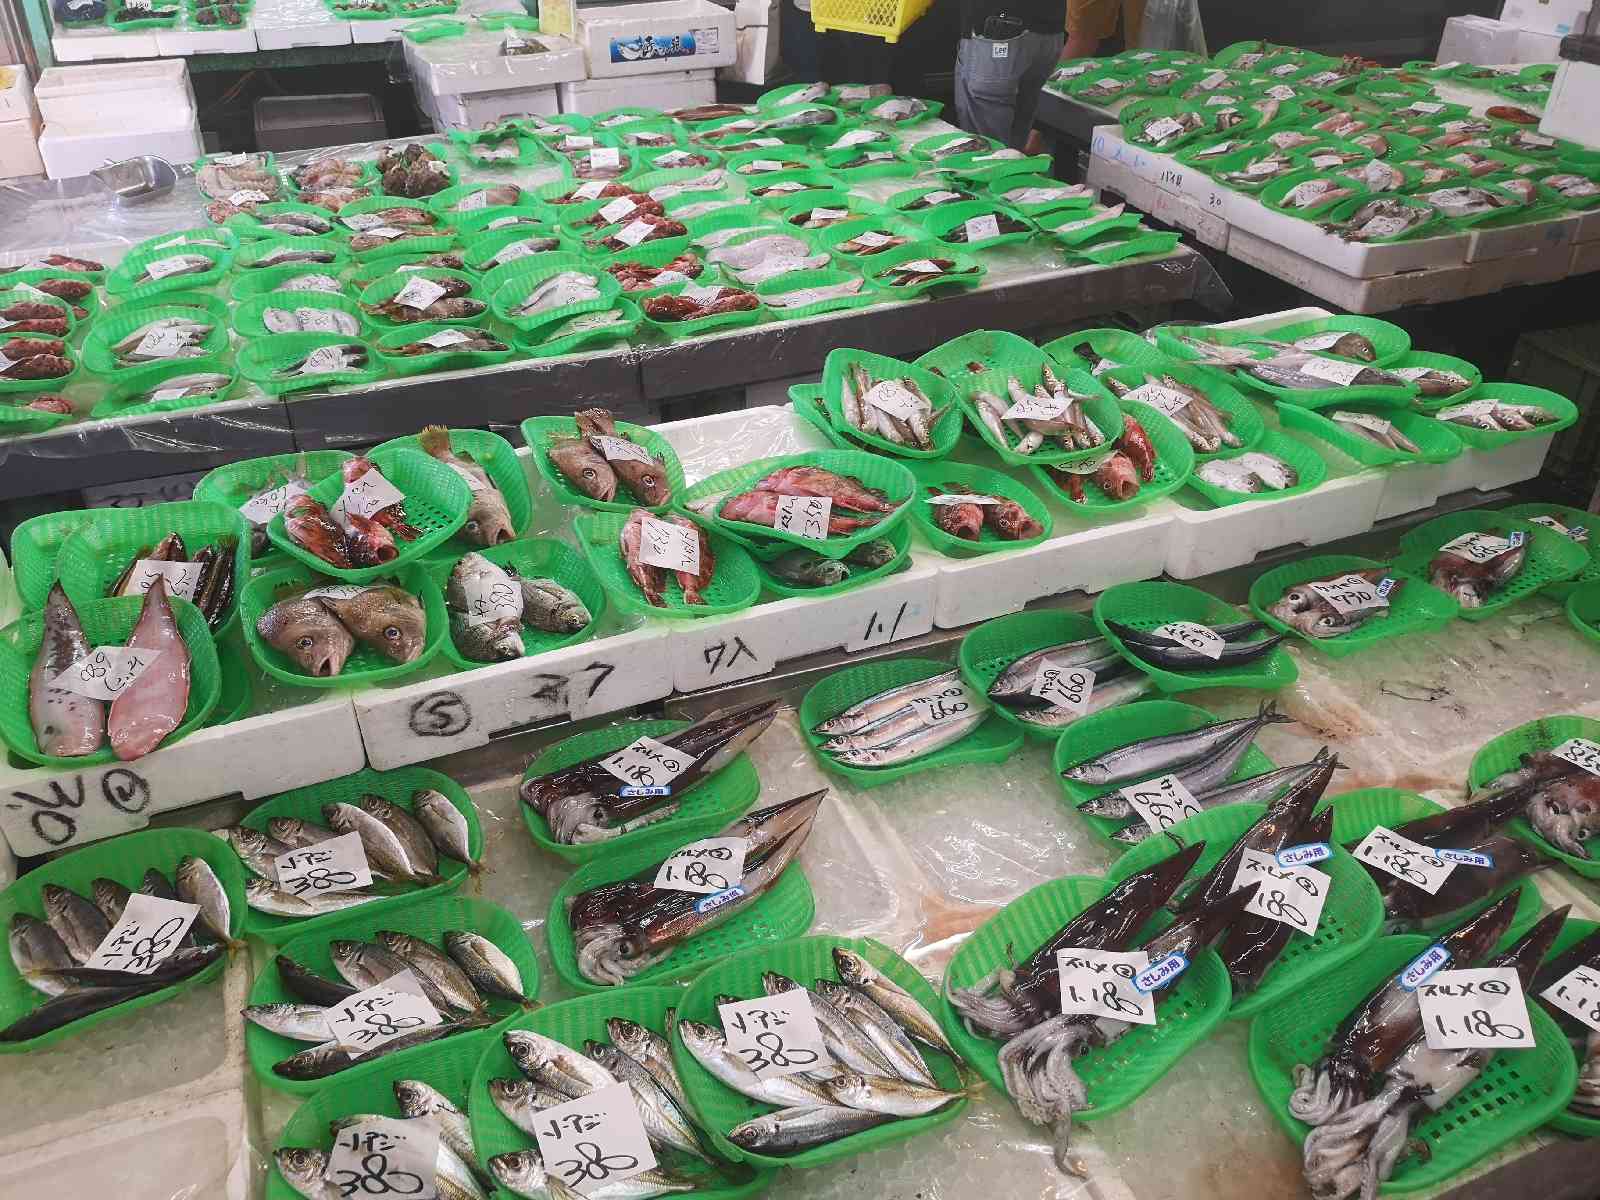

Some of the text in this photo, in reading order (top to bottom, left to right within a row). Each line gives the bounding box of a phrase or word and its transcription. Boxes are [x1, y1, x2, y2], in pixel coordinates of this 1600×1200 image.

[1057, 673, 1086, 704] 660
[930, 700, 969, 721] 660
[1283, 846, 1326, 863] さしみ用
[285, 868, 358, 896] 380
[122, 917, 185, 972] 380
[1142, 960, 1183, 988] さしみ用
[1406, 951, 1442, 985] さしみ用
[1068, 980, 1144, 1018] 1.180
[347, 1013, 426, 1044] 380
[1433, 1008, 1526, 1041] 1.180
[739, 1032, 819, 1073] 380
[336, 1153, 424, 1198] 380
[555, 1142, 639, 1188] 380
